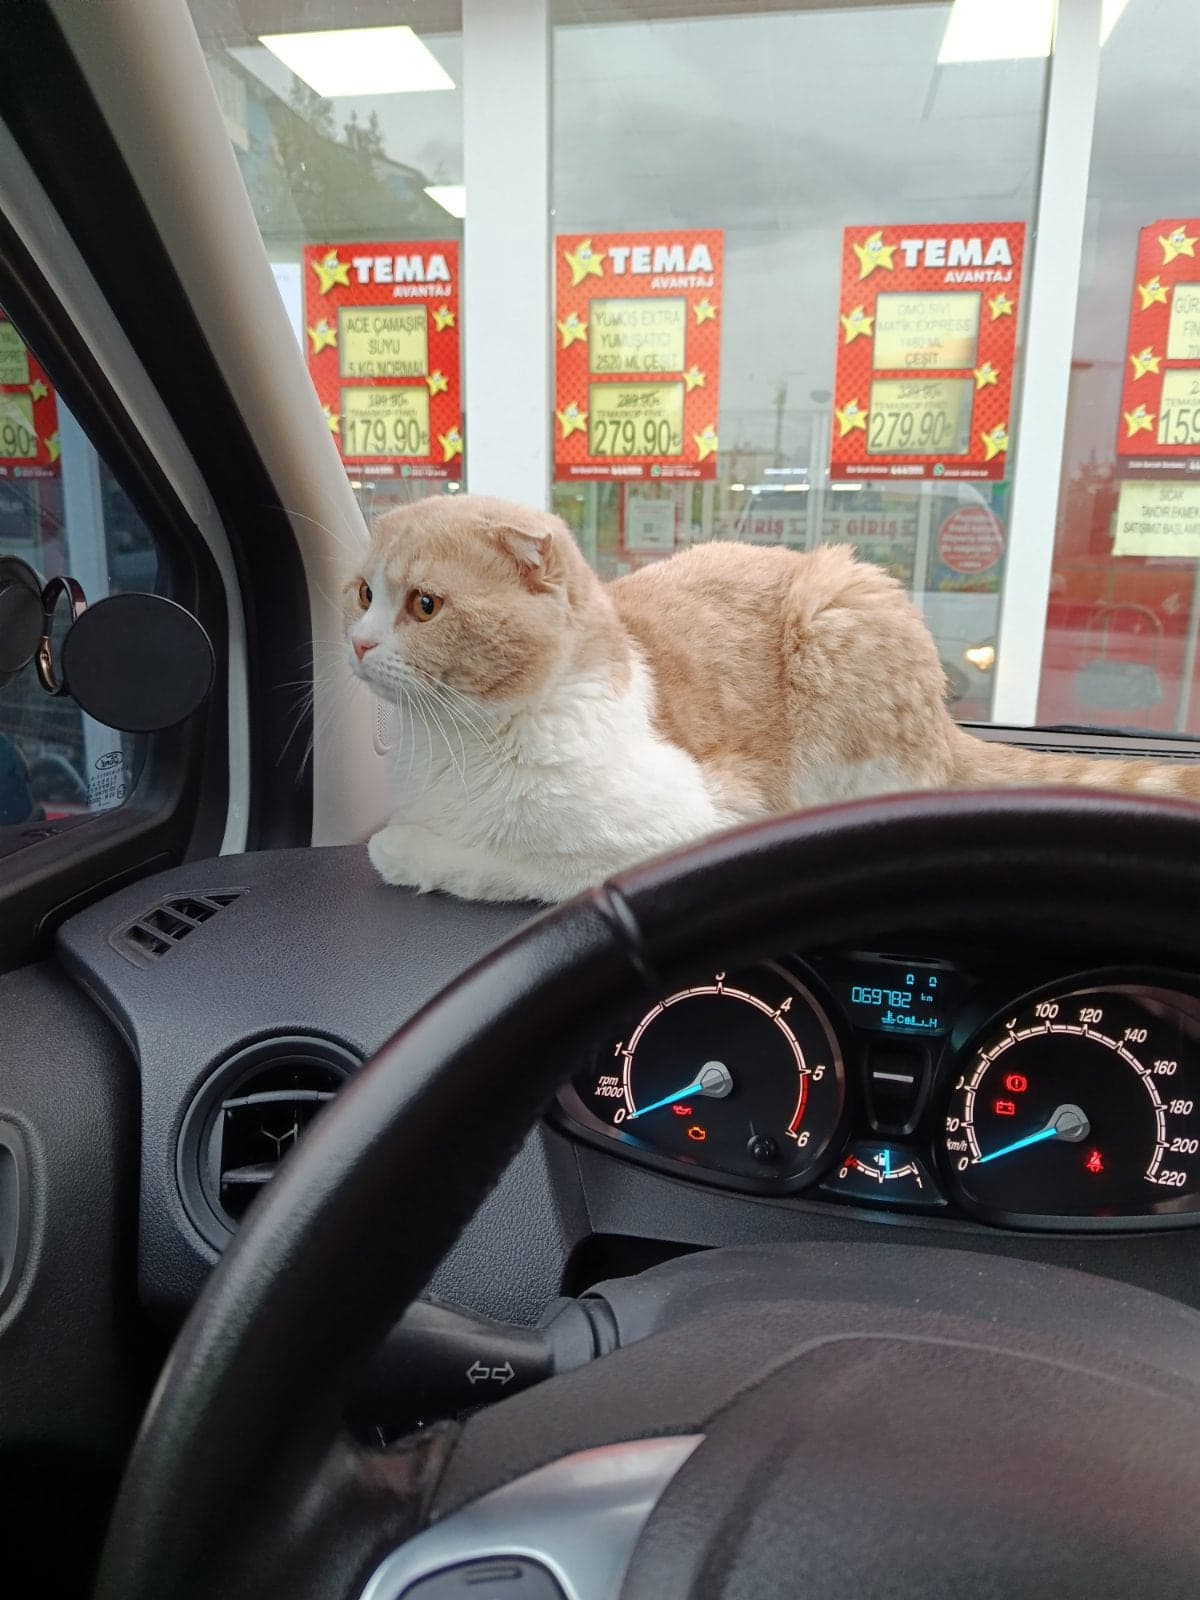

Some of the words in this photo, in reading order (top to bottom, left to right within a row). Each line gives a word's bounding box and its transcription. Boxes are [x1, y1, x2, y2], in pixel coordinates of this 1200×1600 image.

[608, 244, 714, 275] TEMA
[901, 237, 1013, 268] TEMA
[352, 254, 452, 285] TEMA
[944, 271, 1013, 283] AVANTAJ
[650, 276, 714, 290] AVANTAJ
[393, 285, 452, 298] AVANTAJ
[347, 317, 370, 333] ACE
[641, 310, 682, 326] EXTRA
[368, 338, 401, 355] SUYU
[624, 354, 640, 370] ML
[905, 351, 940, 368] ÇEŞİT
[780, 996, 793, 1012] 4
[851, 986, 912, 1009] 069782
[920, 992, 934, 1003] km
[1035, 1002, 1060, 1019] 100
[1079, 1007, 1103, 1023] 120
[1124, 1028, 1148, 1044] 140
[614, 1041, 623, 1057] 1
[812, 1065, 826, 1081] 5
[1152, 1060, 1177, 1076] 160
[599, 1075, 619, 1087] rpm
[594, 1086, 624, 1099] x1000
[1169, 1099, 1194, 1115] 180
[613, 1108, 626, 1124] 0
[797, 1131, 810, 1147] 6
[1170, 1139, 1199, 1153] 200
[957, 1157, 969, 1171] 0
[839, 1167, 848, 1179] 0
[1157, 1170, 1187, 1187] 220
[916, 1176, 924, 1189] 1
